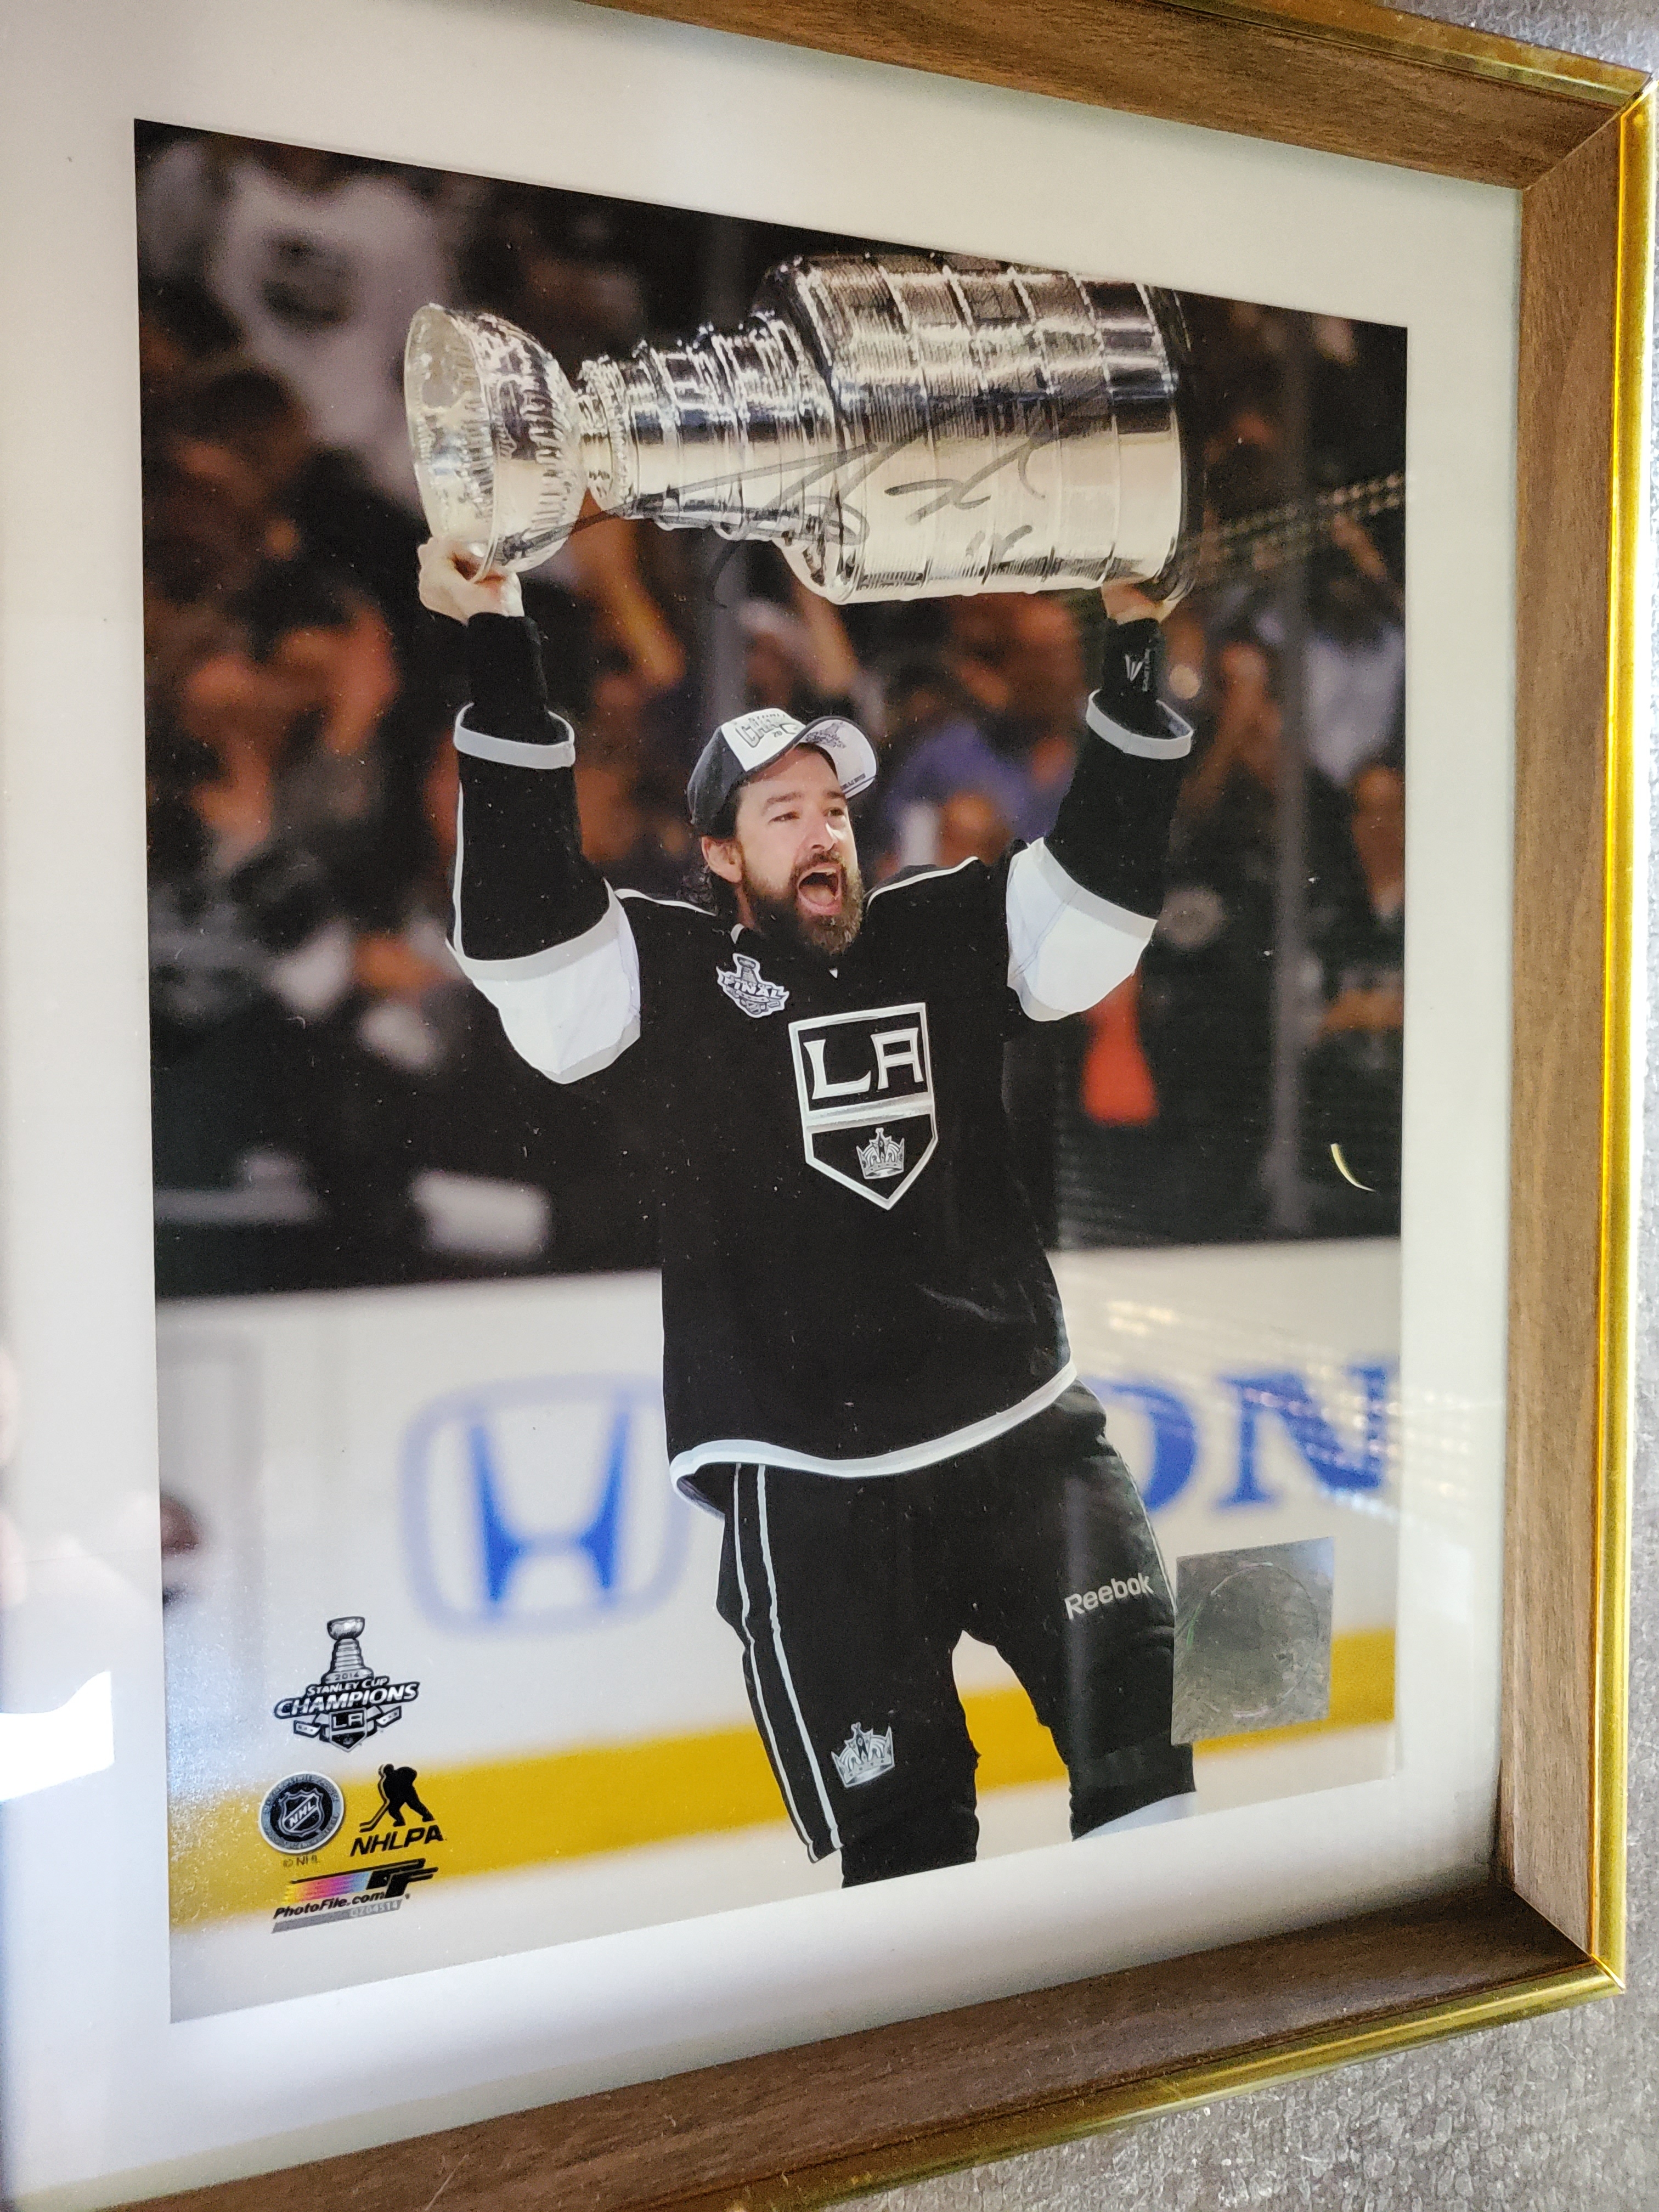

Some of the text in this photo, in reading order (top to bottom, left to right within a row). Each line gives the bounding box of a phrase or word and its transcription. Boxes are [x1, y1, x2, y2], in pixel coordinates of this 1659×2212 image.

[724, 977, 782, 999] FINAL
[803, 1027, 924, 1100] LA
[1064, 1572, 1154, 1620] Reebok
[307, 1678, 388, 1695] STANLEY CUP
[334, 1672, 360, 1681] 2014
[275, 1683, 417, 1717] CHAMPIONS
[332, 1712, 363, 1729] LA
[289, 1801, 317, 1827] NHL
[349, 1825, 444, 1857] NHLPA
[273, 1892, 385, 1920] PhotoFile.com
